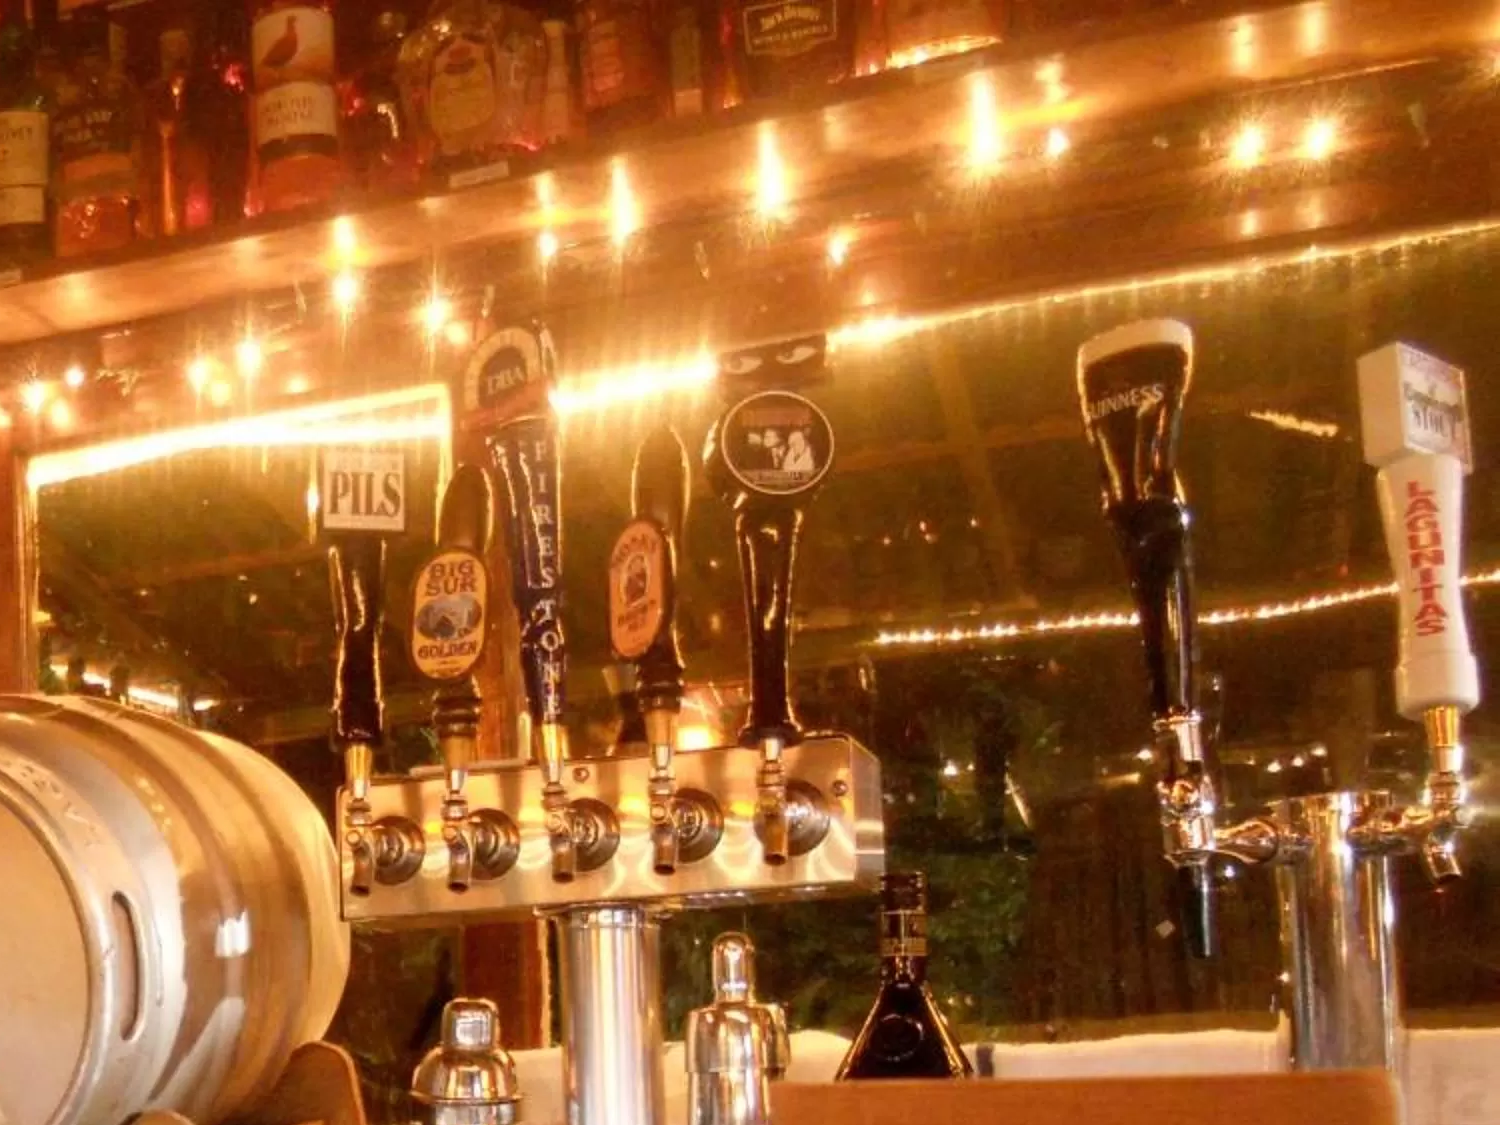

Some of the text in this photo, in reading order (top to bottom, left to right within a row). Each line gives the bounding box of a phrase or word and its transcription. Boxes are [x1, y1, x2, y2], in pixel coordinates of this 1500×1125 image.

[326, 470, 401, 518] PILS
[428, 560, 476, 579] BIG
[1403, 479, 1448, 638] LAGUNITAS
[424, 577, 476, 597] SUR
[533, 438, 565, 724] FIRESTONE
[417, 639, 478, 660] GOLDEN
